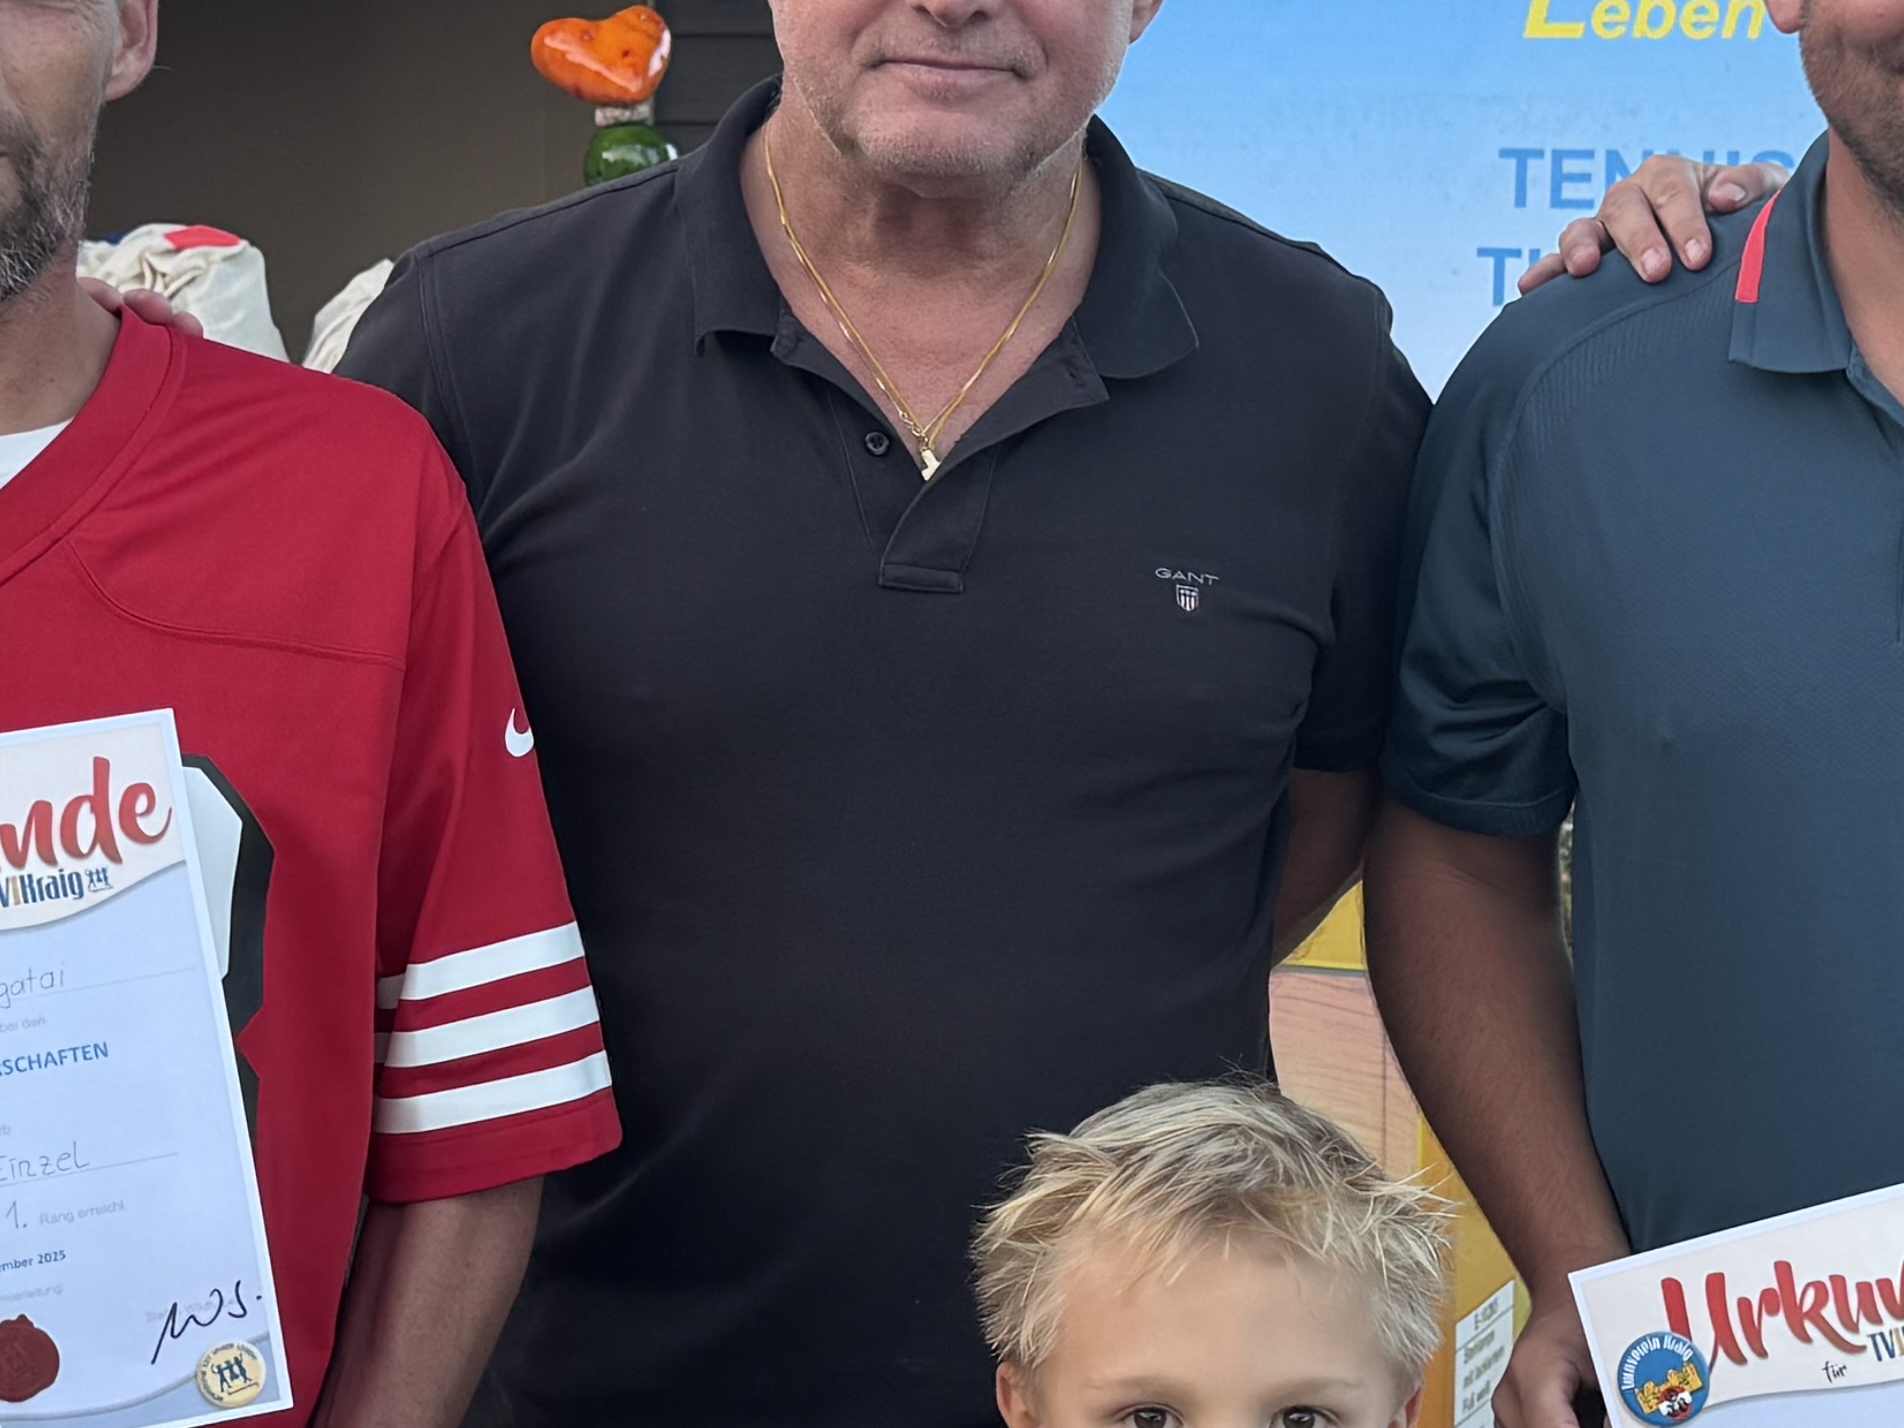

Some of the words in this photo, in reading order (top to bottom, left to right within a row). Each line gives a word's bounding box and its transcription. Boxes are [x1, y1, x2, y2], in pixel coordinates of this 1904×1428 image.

[1154, 567, 1220, 585] GANT
[37, 1249, 67, 1265] 2025
[1822, 1360, 1848, 1384] für
